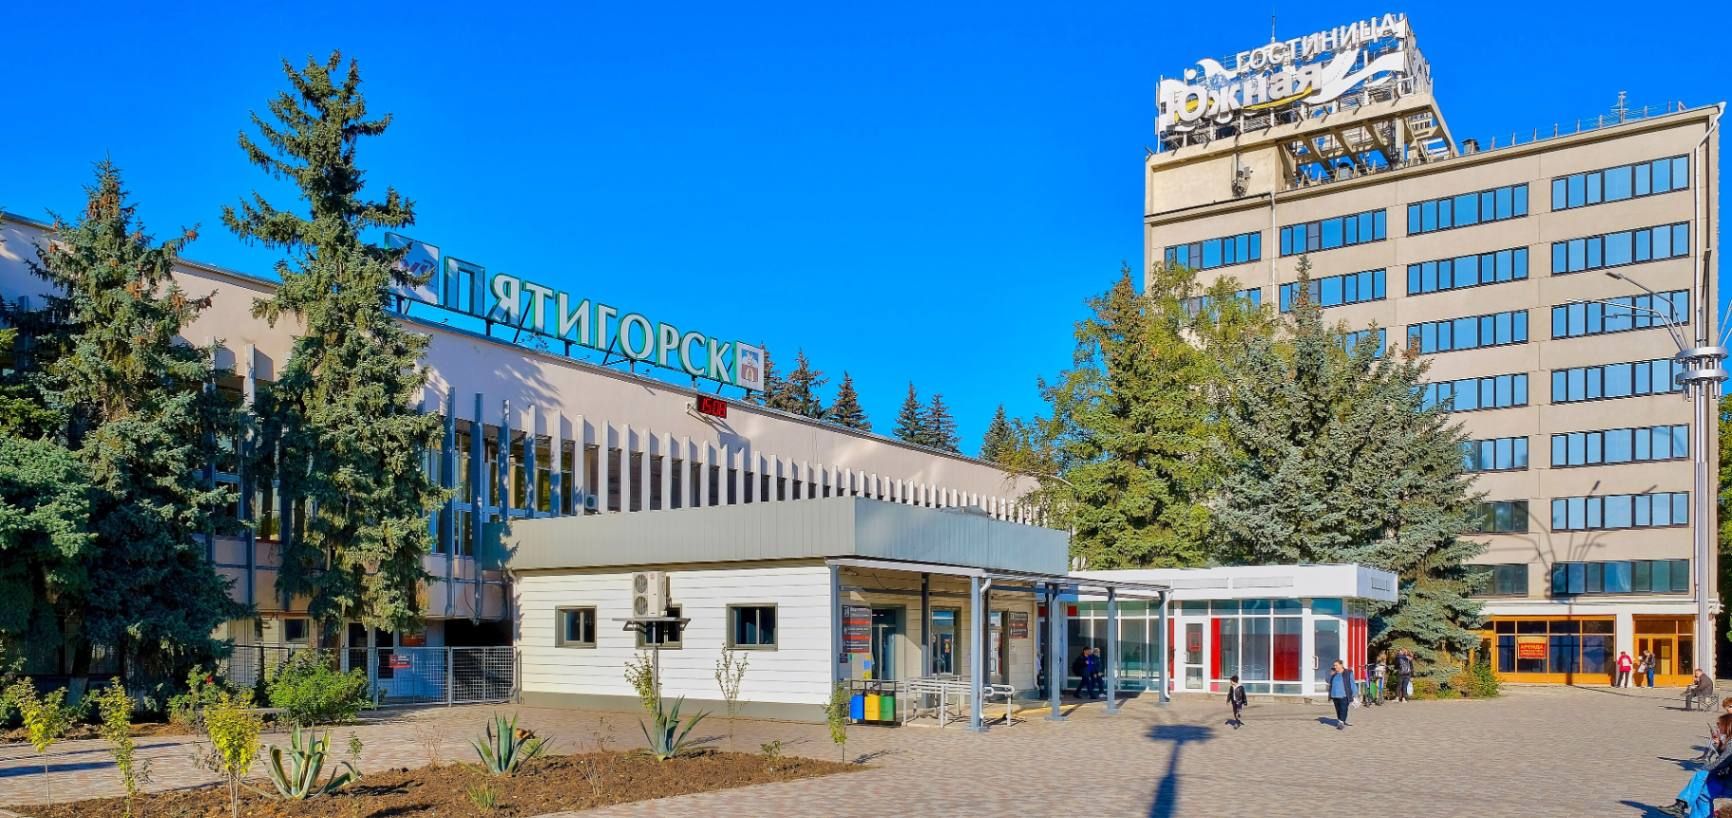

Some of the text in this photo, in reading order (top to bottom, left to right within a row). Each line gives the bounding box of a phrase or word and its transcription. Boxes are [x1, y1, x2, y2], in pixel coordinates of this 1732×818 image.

[1236, 12, 1400, 70] ГОСТИНИЦА
[1164, 62, 1322, 125] Южная
[443, 255, 735, 387] ПЯТИГОРСК
